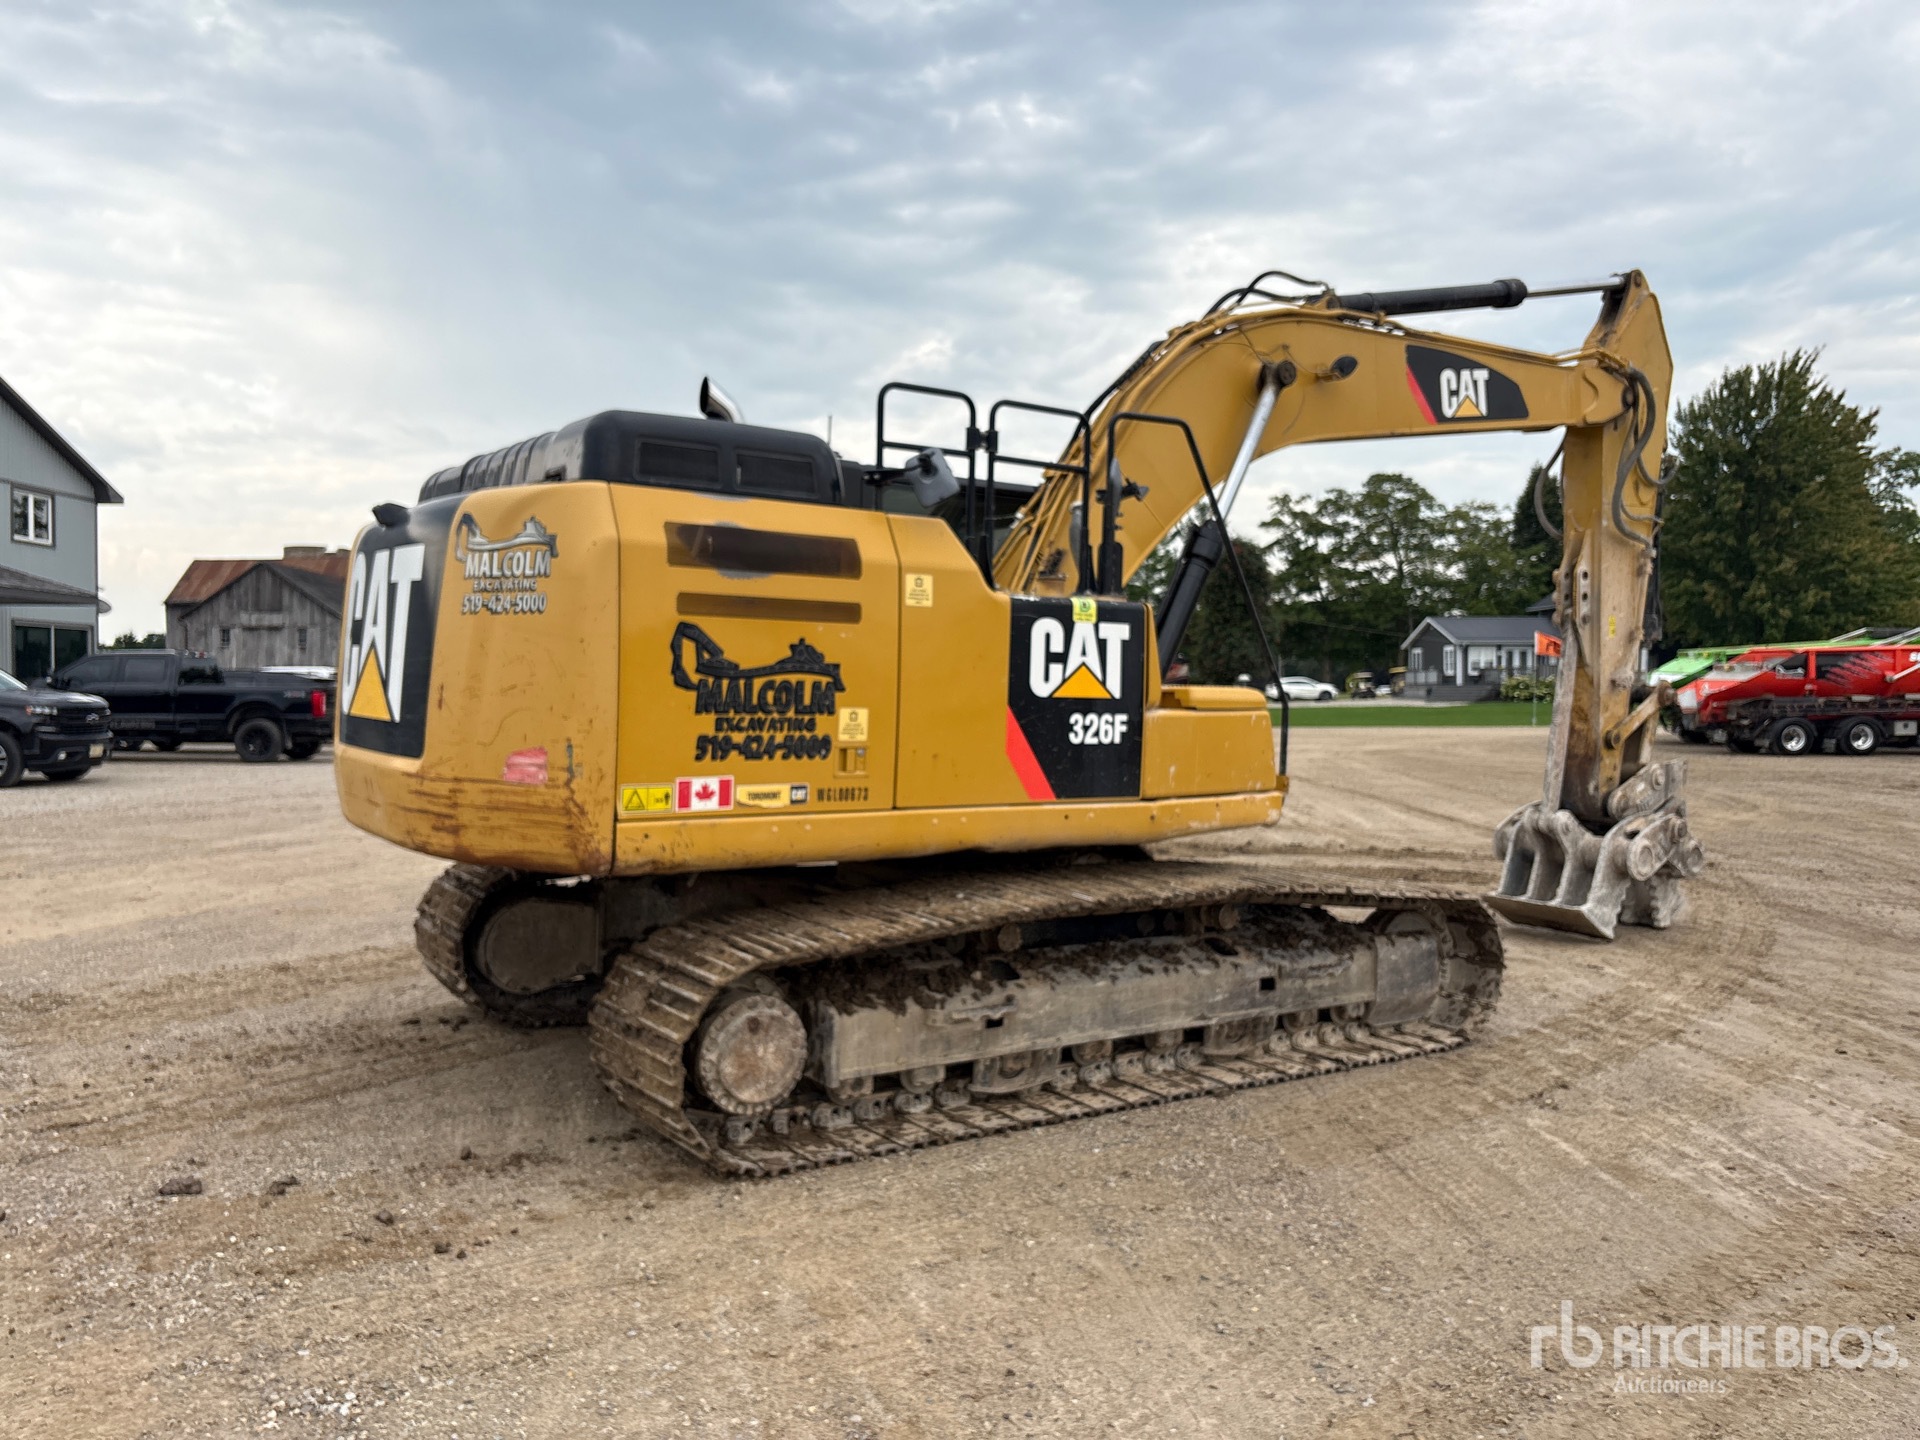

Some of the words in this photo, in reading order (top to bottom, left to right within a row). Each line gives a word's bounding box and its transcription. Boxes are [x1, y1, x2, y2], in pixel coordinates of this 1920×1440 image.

[1440, 368, 1489, 418] CAT
[465, 551, 551, 577] MALCOLM
[473, 580, 537, 591] EXCAVATING
[462, 593, 548, 613] 519-424-5000
[342, 544, 425, 723] CAT
[1029, 617, 1130, 700] CAT
[695, 678, 835, 715] MALCOLM
[714, 717, 816, 732] EXCAVATING
[1068, 712, 1128, 745] 326F
[695, 735, 832, 761] 519-424-5000
[791, 786, 808, 801] CAT
